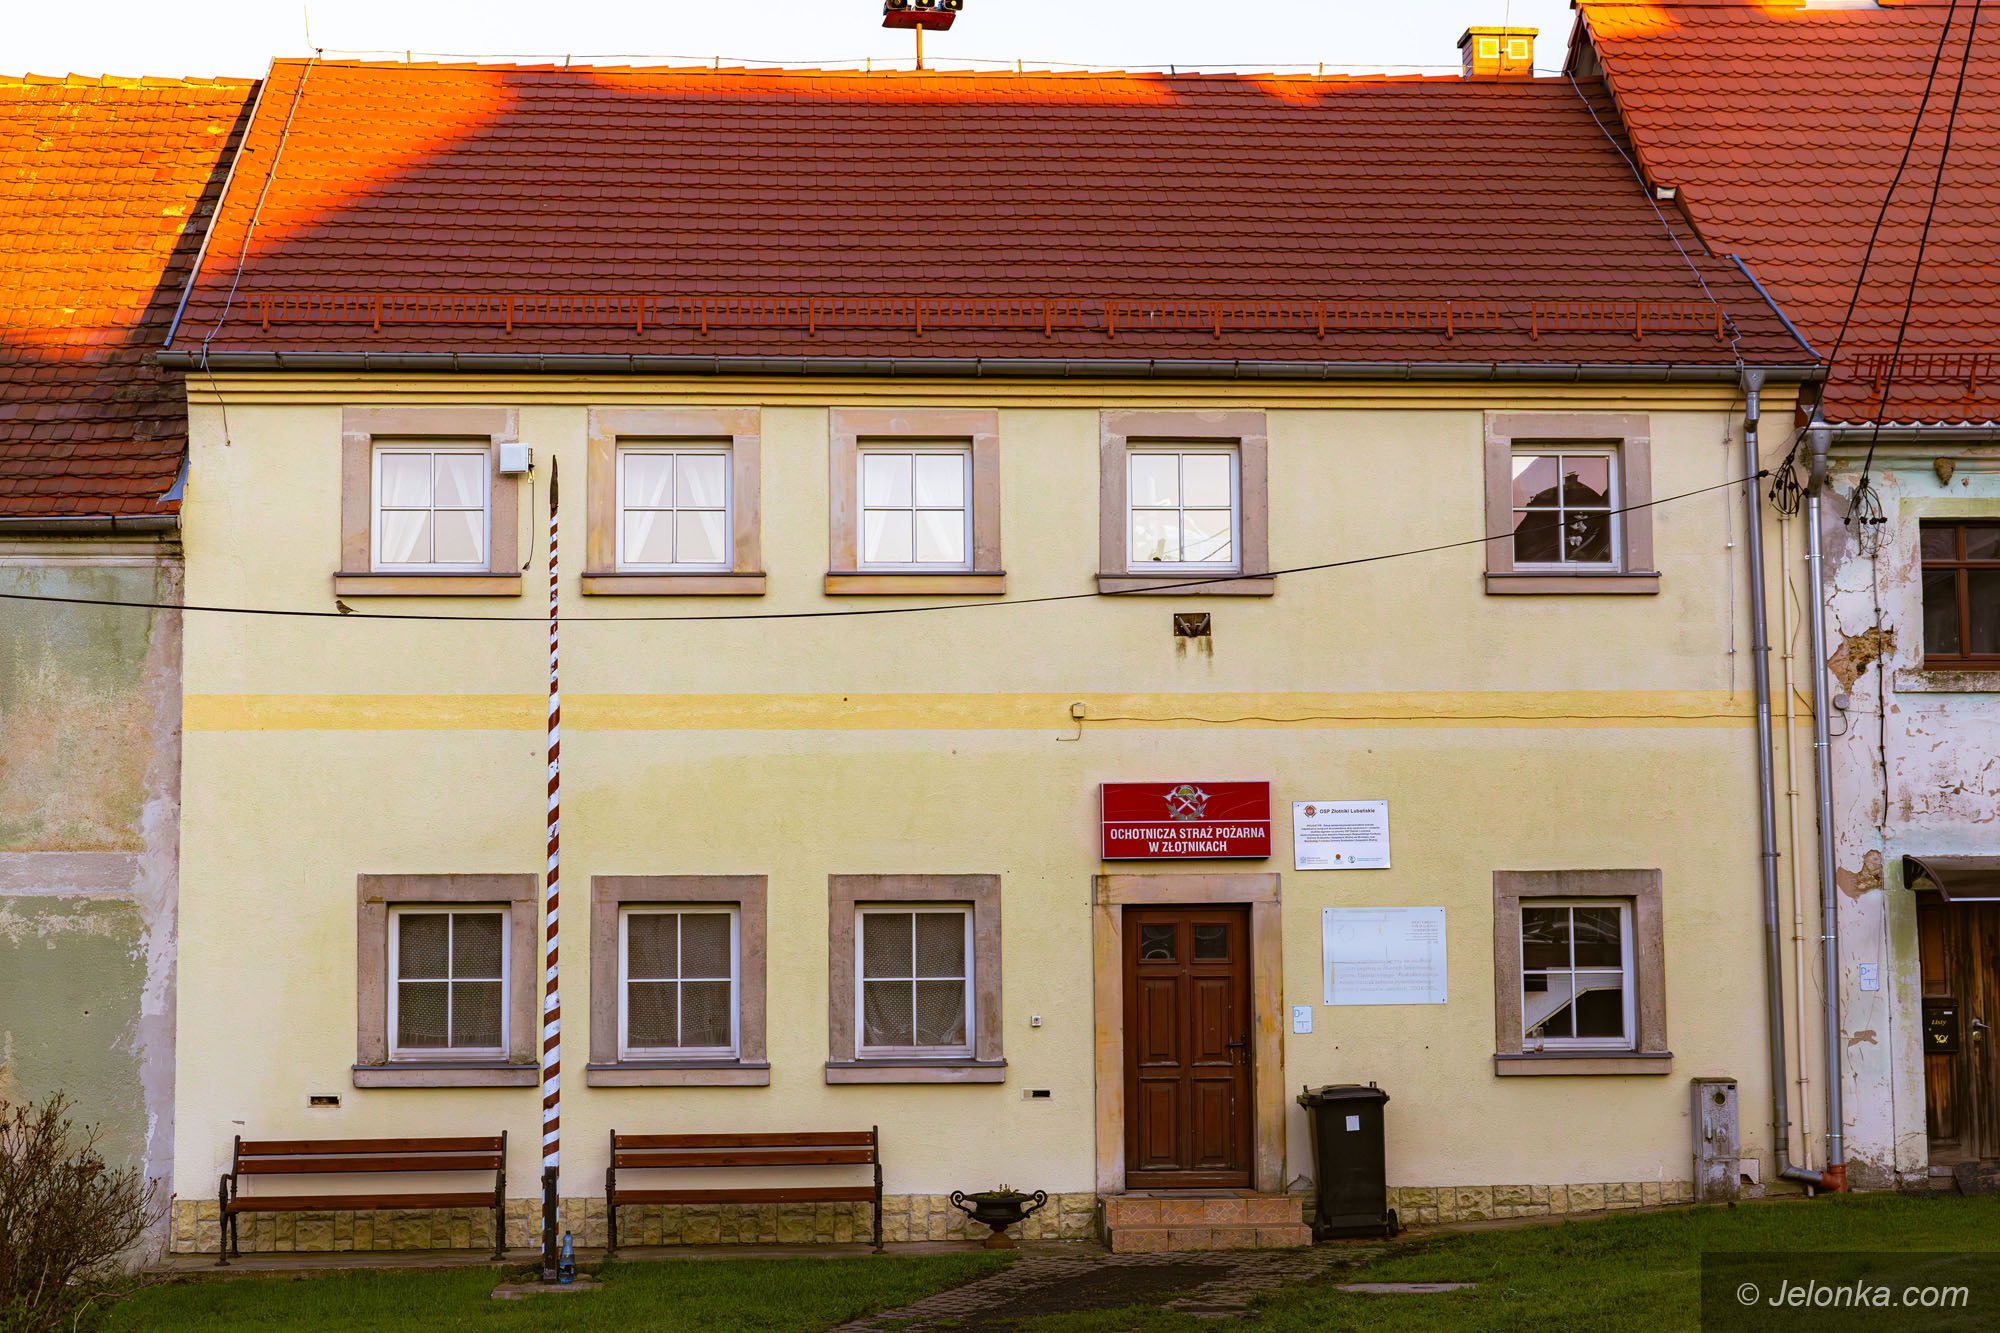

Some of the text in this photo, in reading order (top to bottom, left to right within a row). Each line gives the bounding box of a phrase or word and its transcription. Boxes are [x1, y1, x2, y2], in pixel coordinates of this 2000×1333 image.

[1110, 825, 1265, 840] OCHOTNICZA STRAŻ POŻARNA
[1148, 840, 1227, 853] W ZŁOTNIKACH
